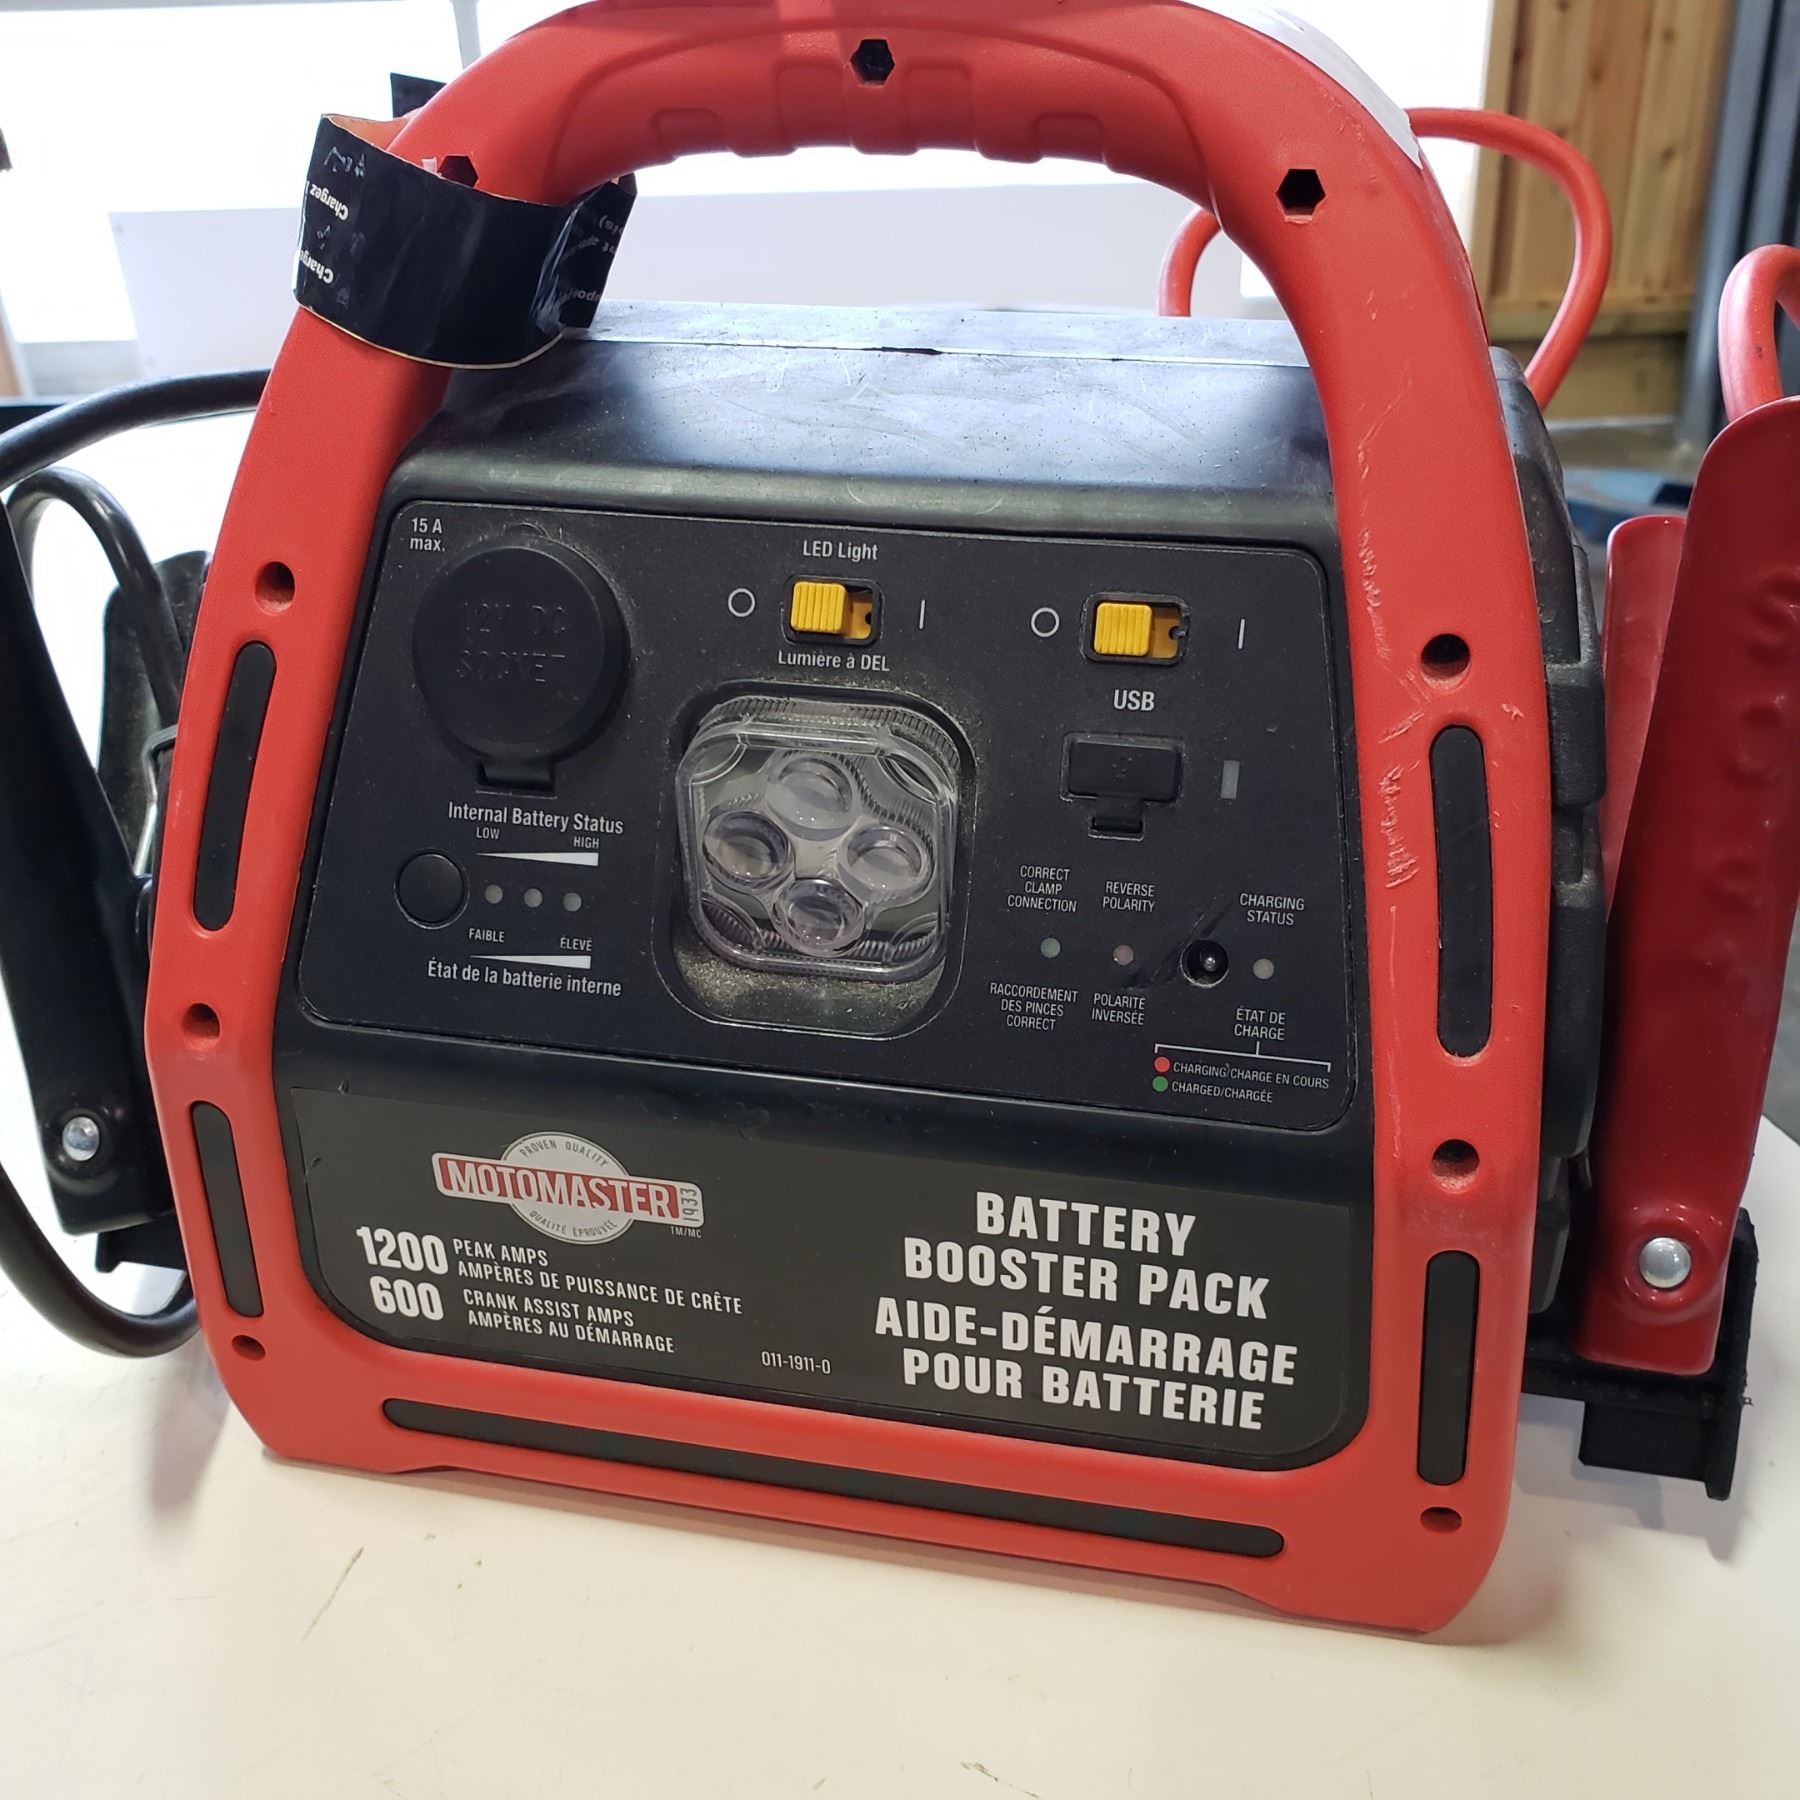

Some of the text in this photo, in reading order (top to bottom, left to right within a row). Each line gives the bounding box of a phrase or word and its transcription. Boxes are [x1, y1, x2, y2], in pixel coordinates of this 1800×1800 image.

[411, 517, 443, 534] 15 A
[409, 536, 446, 552] max.
[803, 539, 879, 563] LED Light
[846, 652, 855, 669] à
[860, 654, 890, 672] DEL
[1113, 689, 1156, 711] USB
[448, 801, 624, 834] Internal Battery Status
[476, 827, 500, 840] LOW
[573, 836, 600, 849] HIGH
[1020, 865, 1071, 881] CORRECT
[1025, 881, 1063, 895] CLAMP
[1105, 881, 1155, 897] REVERSE
[1007, 895, 1077, 913] CONNECTION
[1102, 896, 1156, 913] POLARITY
[1239, 893, 1305, 911] CHARGING
[1246, 910, 1294, 926] STATUS
[469, 927, 505, 943] FAIBLE
[428, 957, 622, 997] État de la batterie interne
[989, 982, 1078, 1003] RACCORDEMENT
[1001, 999, 1064, 1017] DES PINCES
[1091, 1007, 1145, 1026] INVERSÉE
[1236, 1006, 1286, 1025] ÉTAT DE
[1006, 1014, 1057, 1031] CORRECT
[1234, 1023, 1286, 1041] CHARGE
[1275, 1073, 1290, 1085] EN
[1292, 1075, 1330, 1089] COURS
[1171, 1081, 1274, 1103] CHARGED/CHARGÉE
[519, 1139, 610, 1168] PROVEN QUALITY
[445, 1160, 673, 1219] MOTOMASTER
[680, 1187, 701, 1222] 1933
[670, 1226, 702, 1239] TM/MC
[976, 1191, 1197, 1257] BATTERY
[355, 1226, 450, 1275] 1200
[452, 1238, 549, 1267] PEAK AMPS
[458, 1260, 743, 1315] AMPÈRES DE PUISSANCE DE CRÊTE
[904, 1236, 1270, 1320] BOOSTER PACK
[369, 1276, 444, 1321] 600
[463, 1288, 634, 1327] CRANK ASSIST AMPS
[468, 1309, 675, 1353] AMPÈRES AU DÉMARRAGE
[874, 1296, 1298, 1386] AIDE-DÉMARRAGE
[761, 1351, 831, 1374] 011-1911-0
[903, 1347, 1265, 1431] POUR BATTERIE
